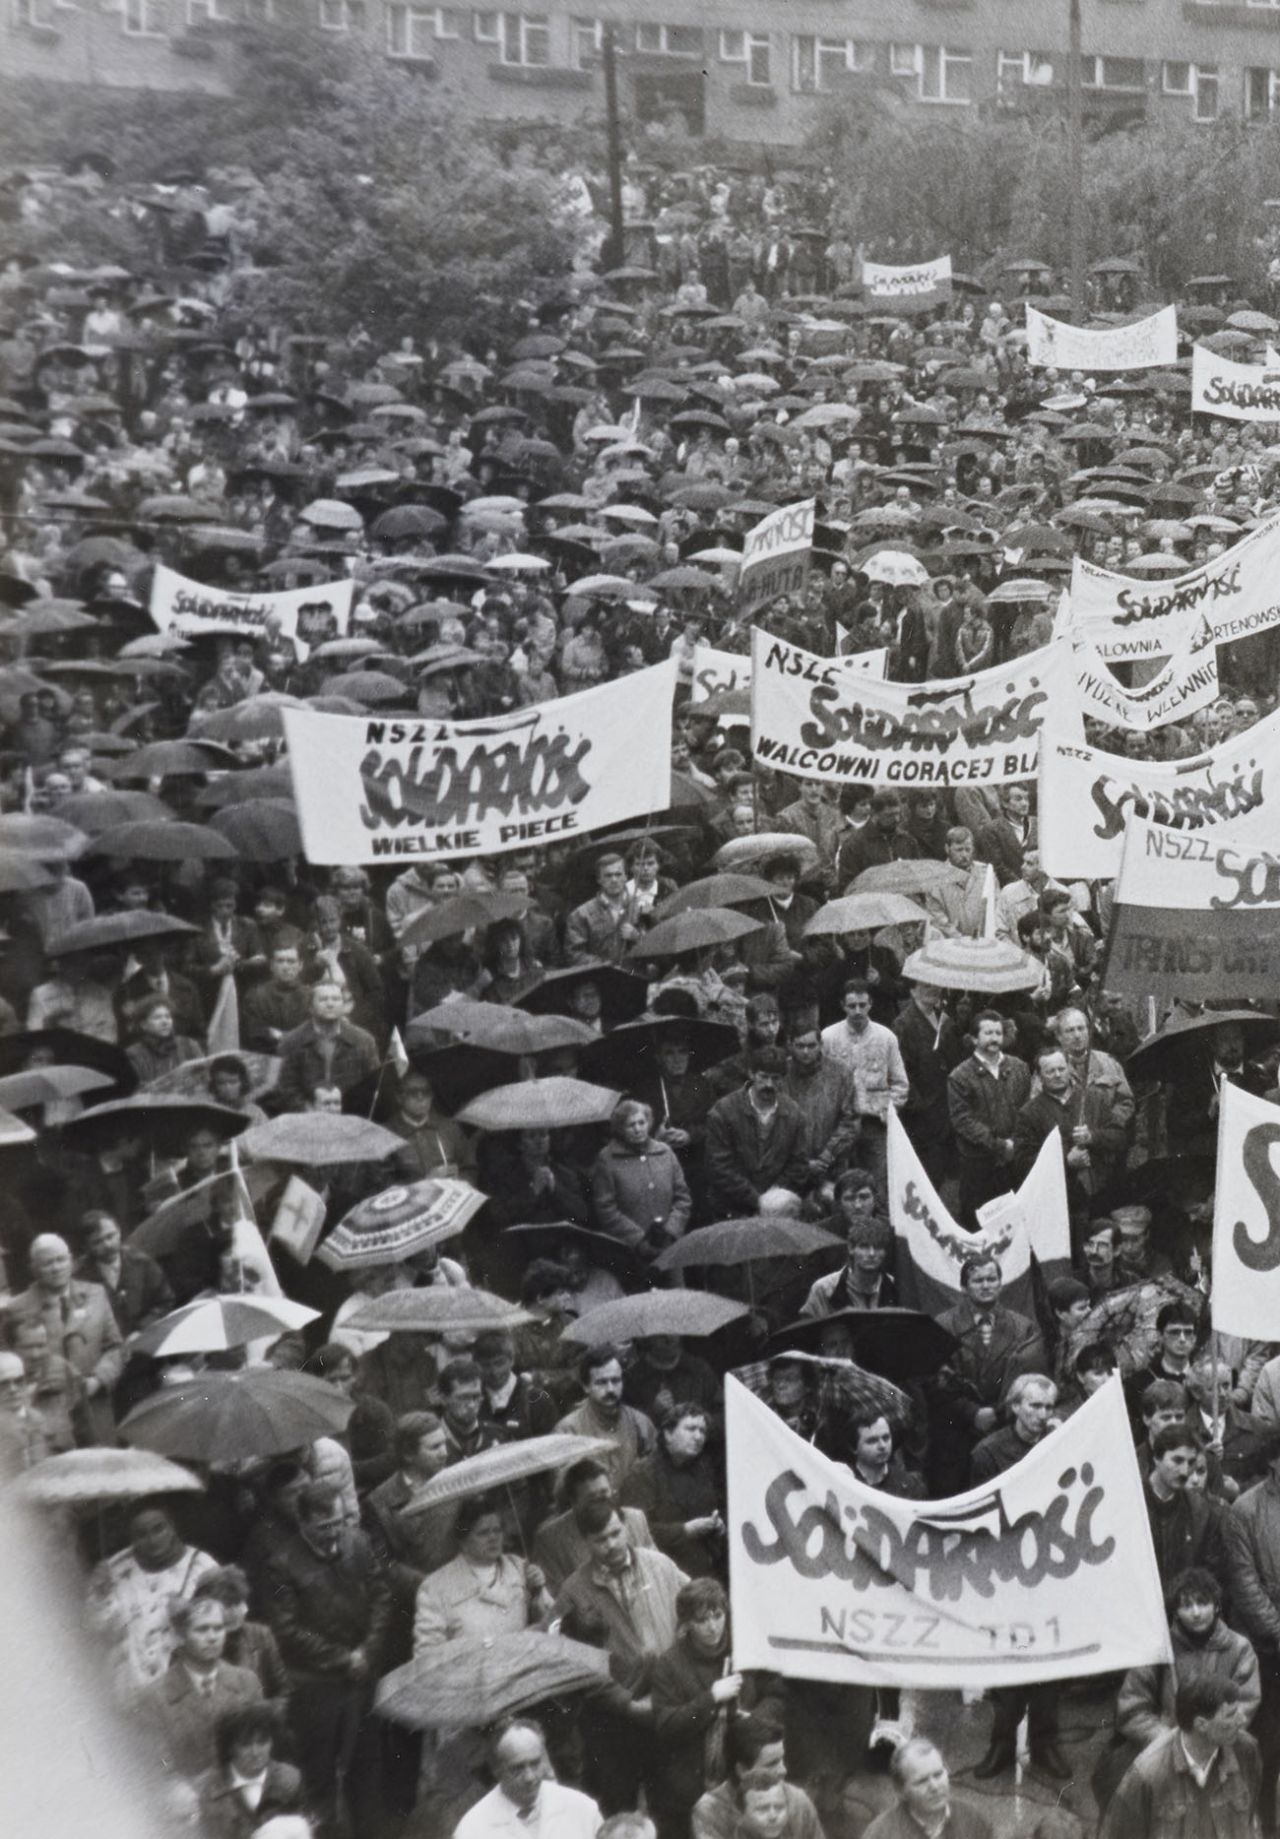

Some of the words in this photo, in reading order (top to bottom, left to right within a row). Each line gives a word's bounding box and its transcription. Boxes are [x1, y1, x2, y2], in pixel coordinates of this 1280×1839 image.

[365, 721, 451, 745] NSZZ
[756, 735, 880, 779] WALCOWNI
[886, 756, 995, 788] GORĄCEJ
[370, 829, 482, 857] WIELKIE
[499, 811, 580, 844] PIECE
[1145, 827, 1216, 863] NSZZ
[819, 1605, 941, 1651] NSZZ
